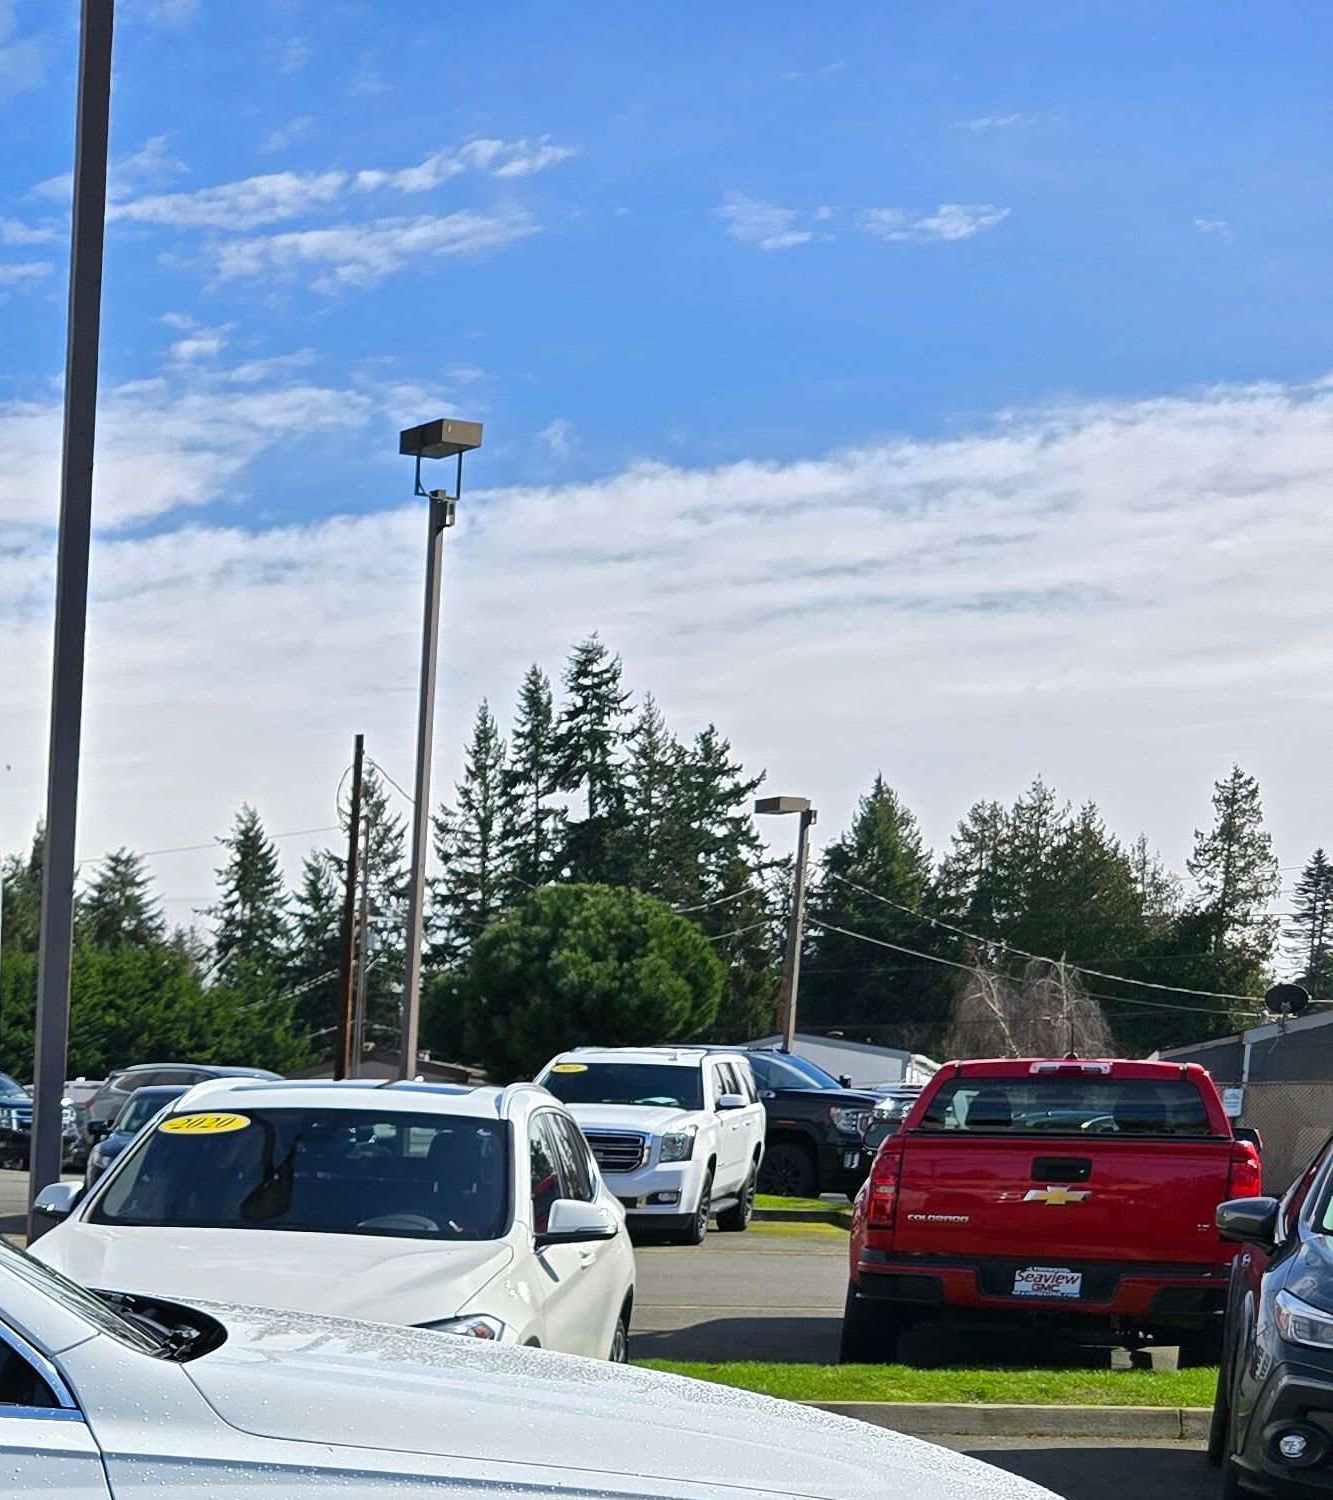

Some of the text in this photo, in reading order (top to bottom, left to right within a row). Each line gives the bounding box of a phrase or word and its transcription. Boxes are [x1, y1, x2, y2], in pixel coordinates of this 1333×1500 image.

[168, 1117, 237, 1130] 2020
[907, 1213, 970, 1223] COLORADO
[1013, 1269, 1081, 1285] Seaview
[1032, 1283, 1061, 1293] GMC
